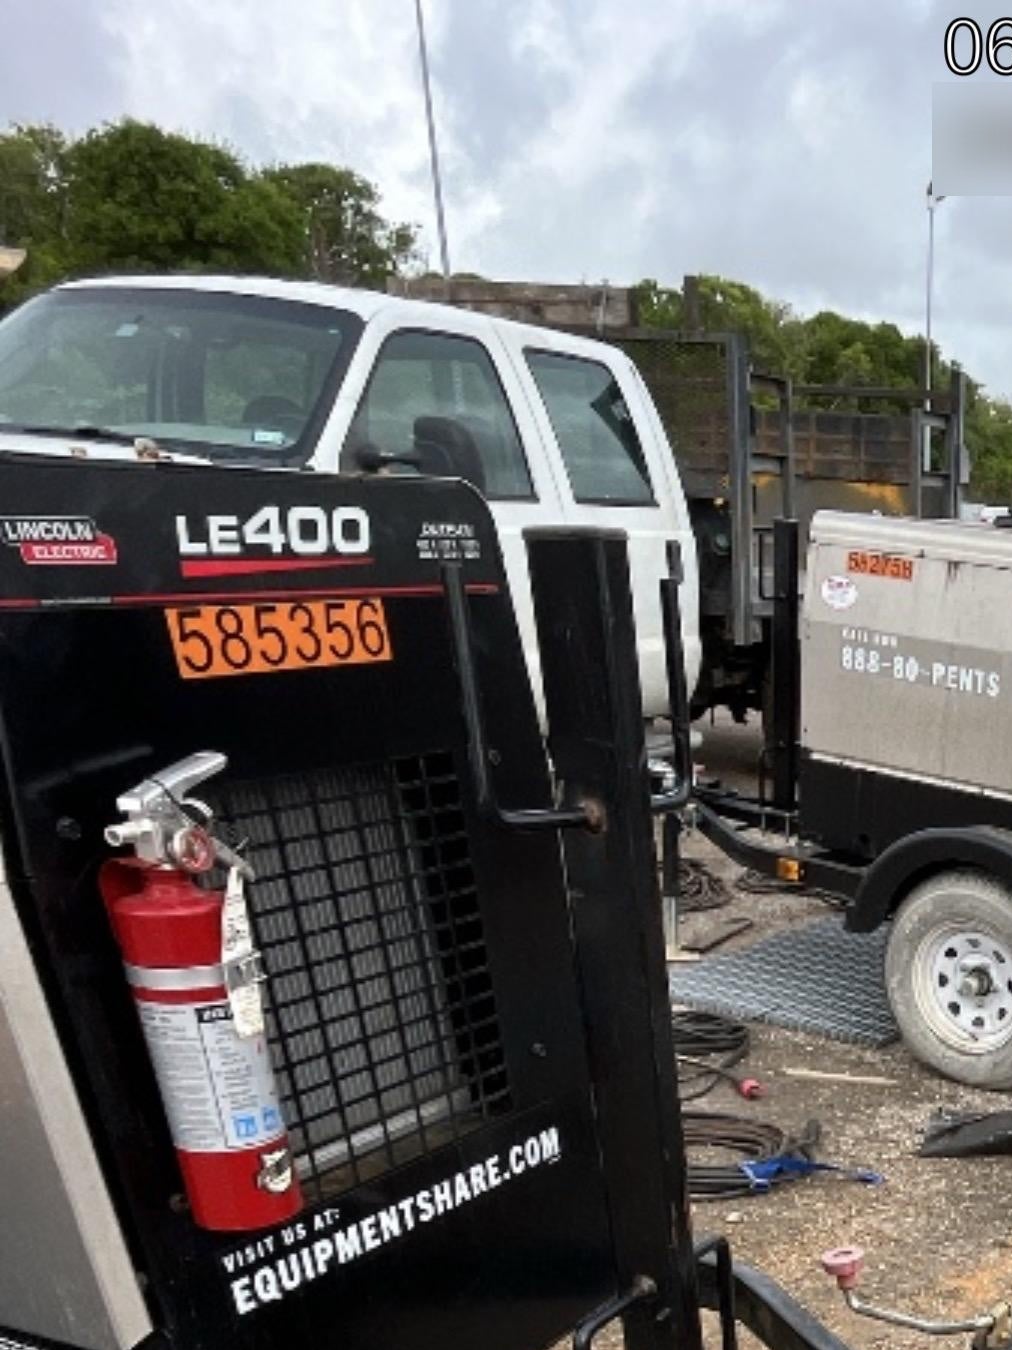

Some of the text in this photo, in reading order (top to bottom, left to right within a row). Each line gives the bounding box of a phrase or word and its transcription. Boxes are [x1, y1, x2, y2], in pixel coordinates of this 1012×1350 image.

[4, 521, 95, 541] LINCOLN
[31, 545, 108, 560] ELECTRIC
[175, 505, 370, 554] LE400
[176, 600, 385, 673] 585356
[230, 1127, 561, 1315] EQUIPMENTSHARE.COM
[222, 1235, 275, 1273] VISIT
[281, 1222, 307, 1246] US
